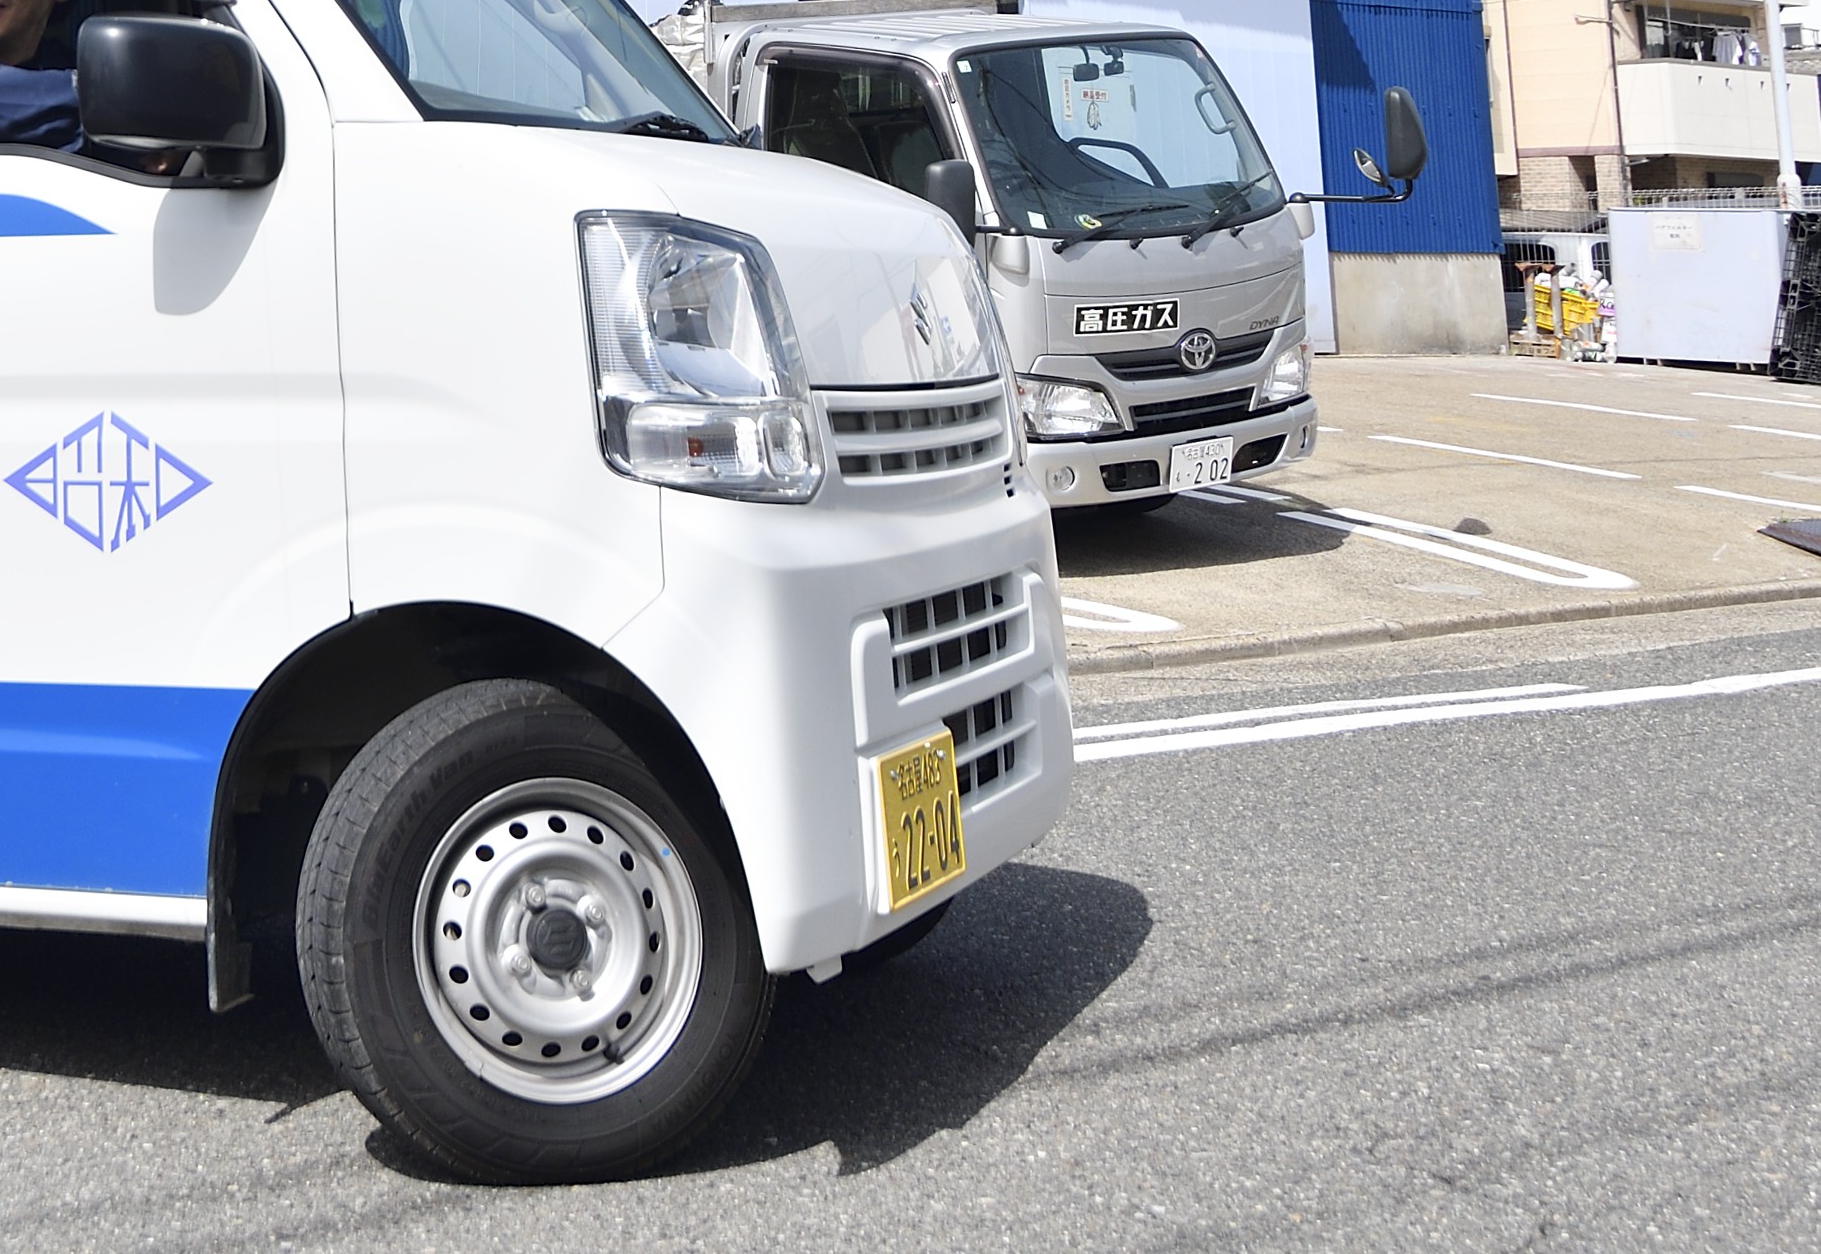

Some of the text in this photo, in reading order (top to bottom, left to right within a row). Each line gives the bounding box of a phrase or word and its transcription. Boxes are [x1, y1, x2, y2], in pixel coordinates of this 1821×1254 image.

[1079, 303, 1174, 333] 高圧ガス
[1249, 315, 1280, 331] DYNA
